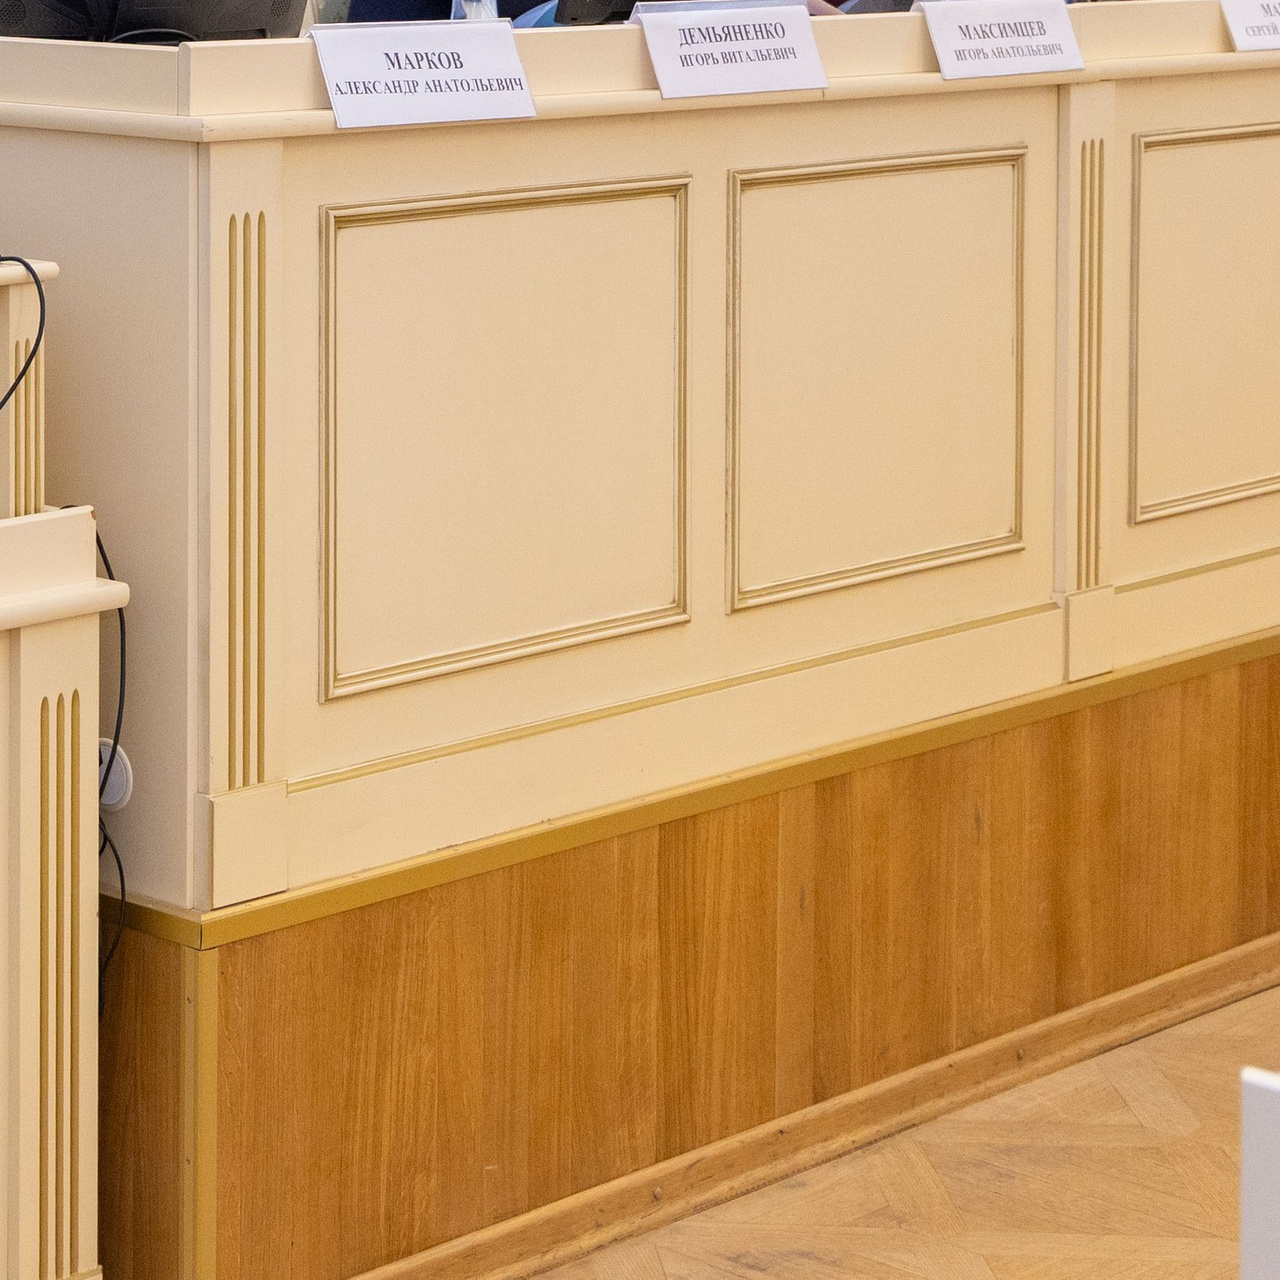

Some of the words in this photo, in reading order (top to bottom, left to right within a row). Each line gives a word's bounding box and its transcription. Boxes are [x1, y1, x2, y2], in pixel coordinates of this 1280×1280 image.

[1260, 3, 1280, 18] МА
[678, 22, 786, 47] ДЕМЬЯНЕНКО
[958, 21, 1047, 41] МАКСИМЦЕВ
[1245, 22, 1279, 37] СЕРГЕЙ
[384, 52, 464, 70] МАРКОВ
[679, 52, 719, 67] ИГОРЬ
[721, 47, 797, 65] ВИТАЛЬЕВИЧ
[954, 48, 989, 61] ИГОРЬ
[991, 43, 1064, 58] АНАТОЛЬЕВИЧ
[335, 80, 419, 96] АЛЕКСАНДР
[424, 77, 524, 93] АНАТОЛЬЕВИЧ
